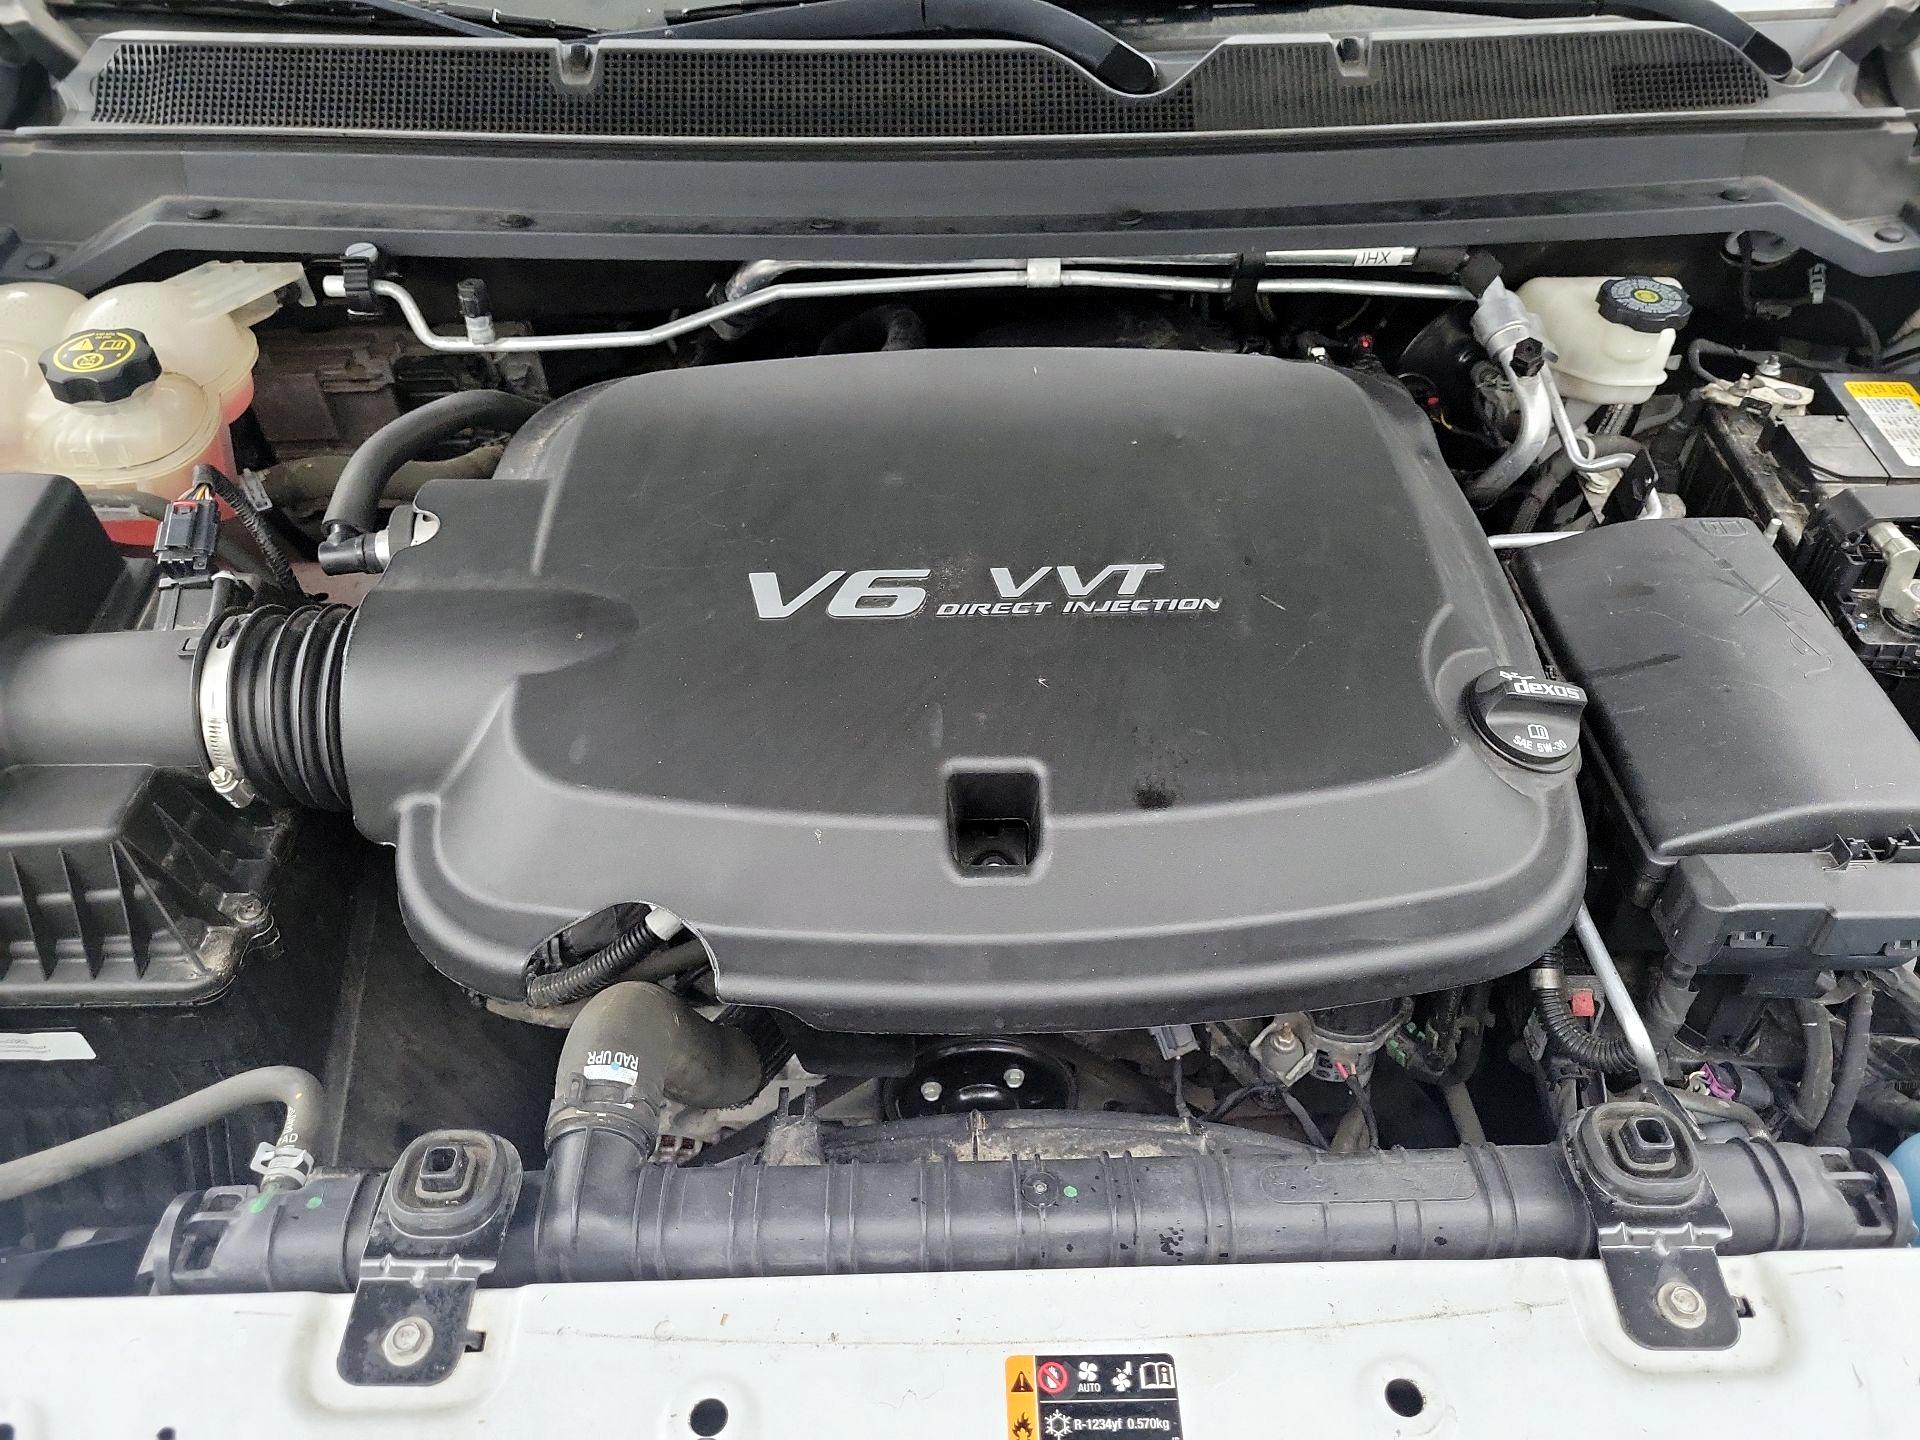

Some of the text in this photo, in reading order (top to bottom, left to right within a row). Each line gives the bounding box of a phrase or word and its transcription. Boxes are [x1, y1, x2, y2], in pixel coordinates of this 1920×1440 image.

[1360, 251, 1392, 265] IHX
[989, 562, 1165, 599] VVT
[748, 568, 932, 620] V6
[935, 597, 1222, 617] DIRECT INJECTION
[1513, 679, 1581, 700] dexos
[1512, 735, 1568, 754] SAE 5W-30
[586, 1050, 639, 1071] RAD UPR
[1077, 1382, 1101, 1393] AUTO
[1073, 1417, 1170, 1432] R-1234yf 0.570kg
